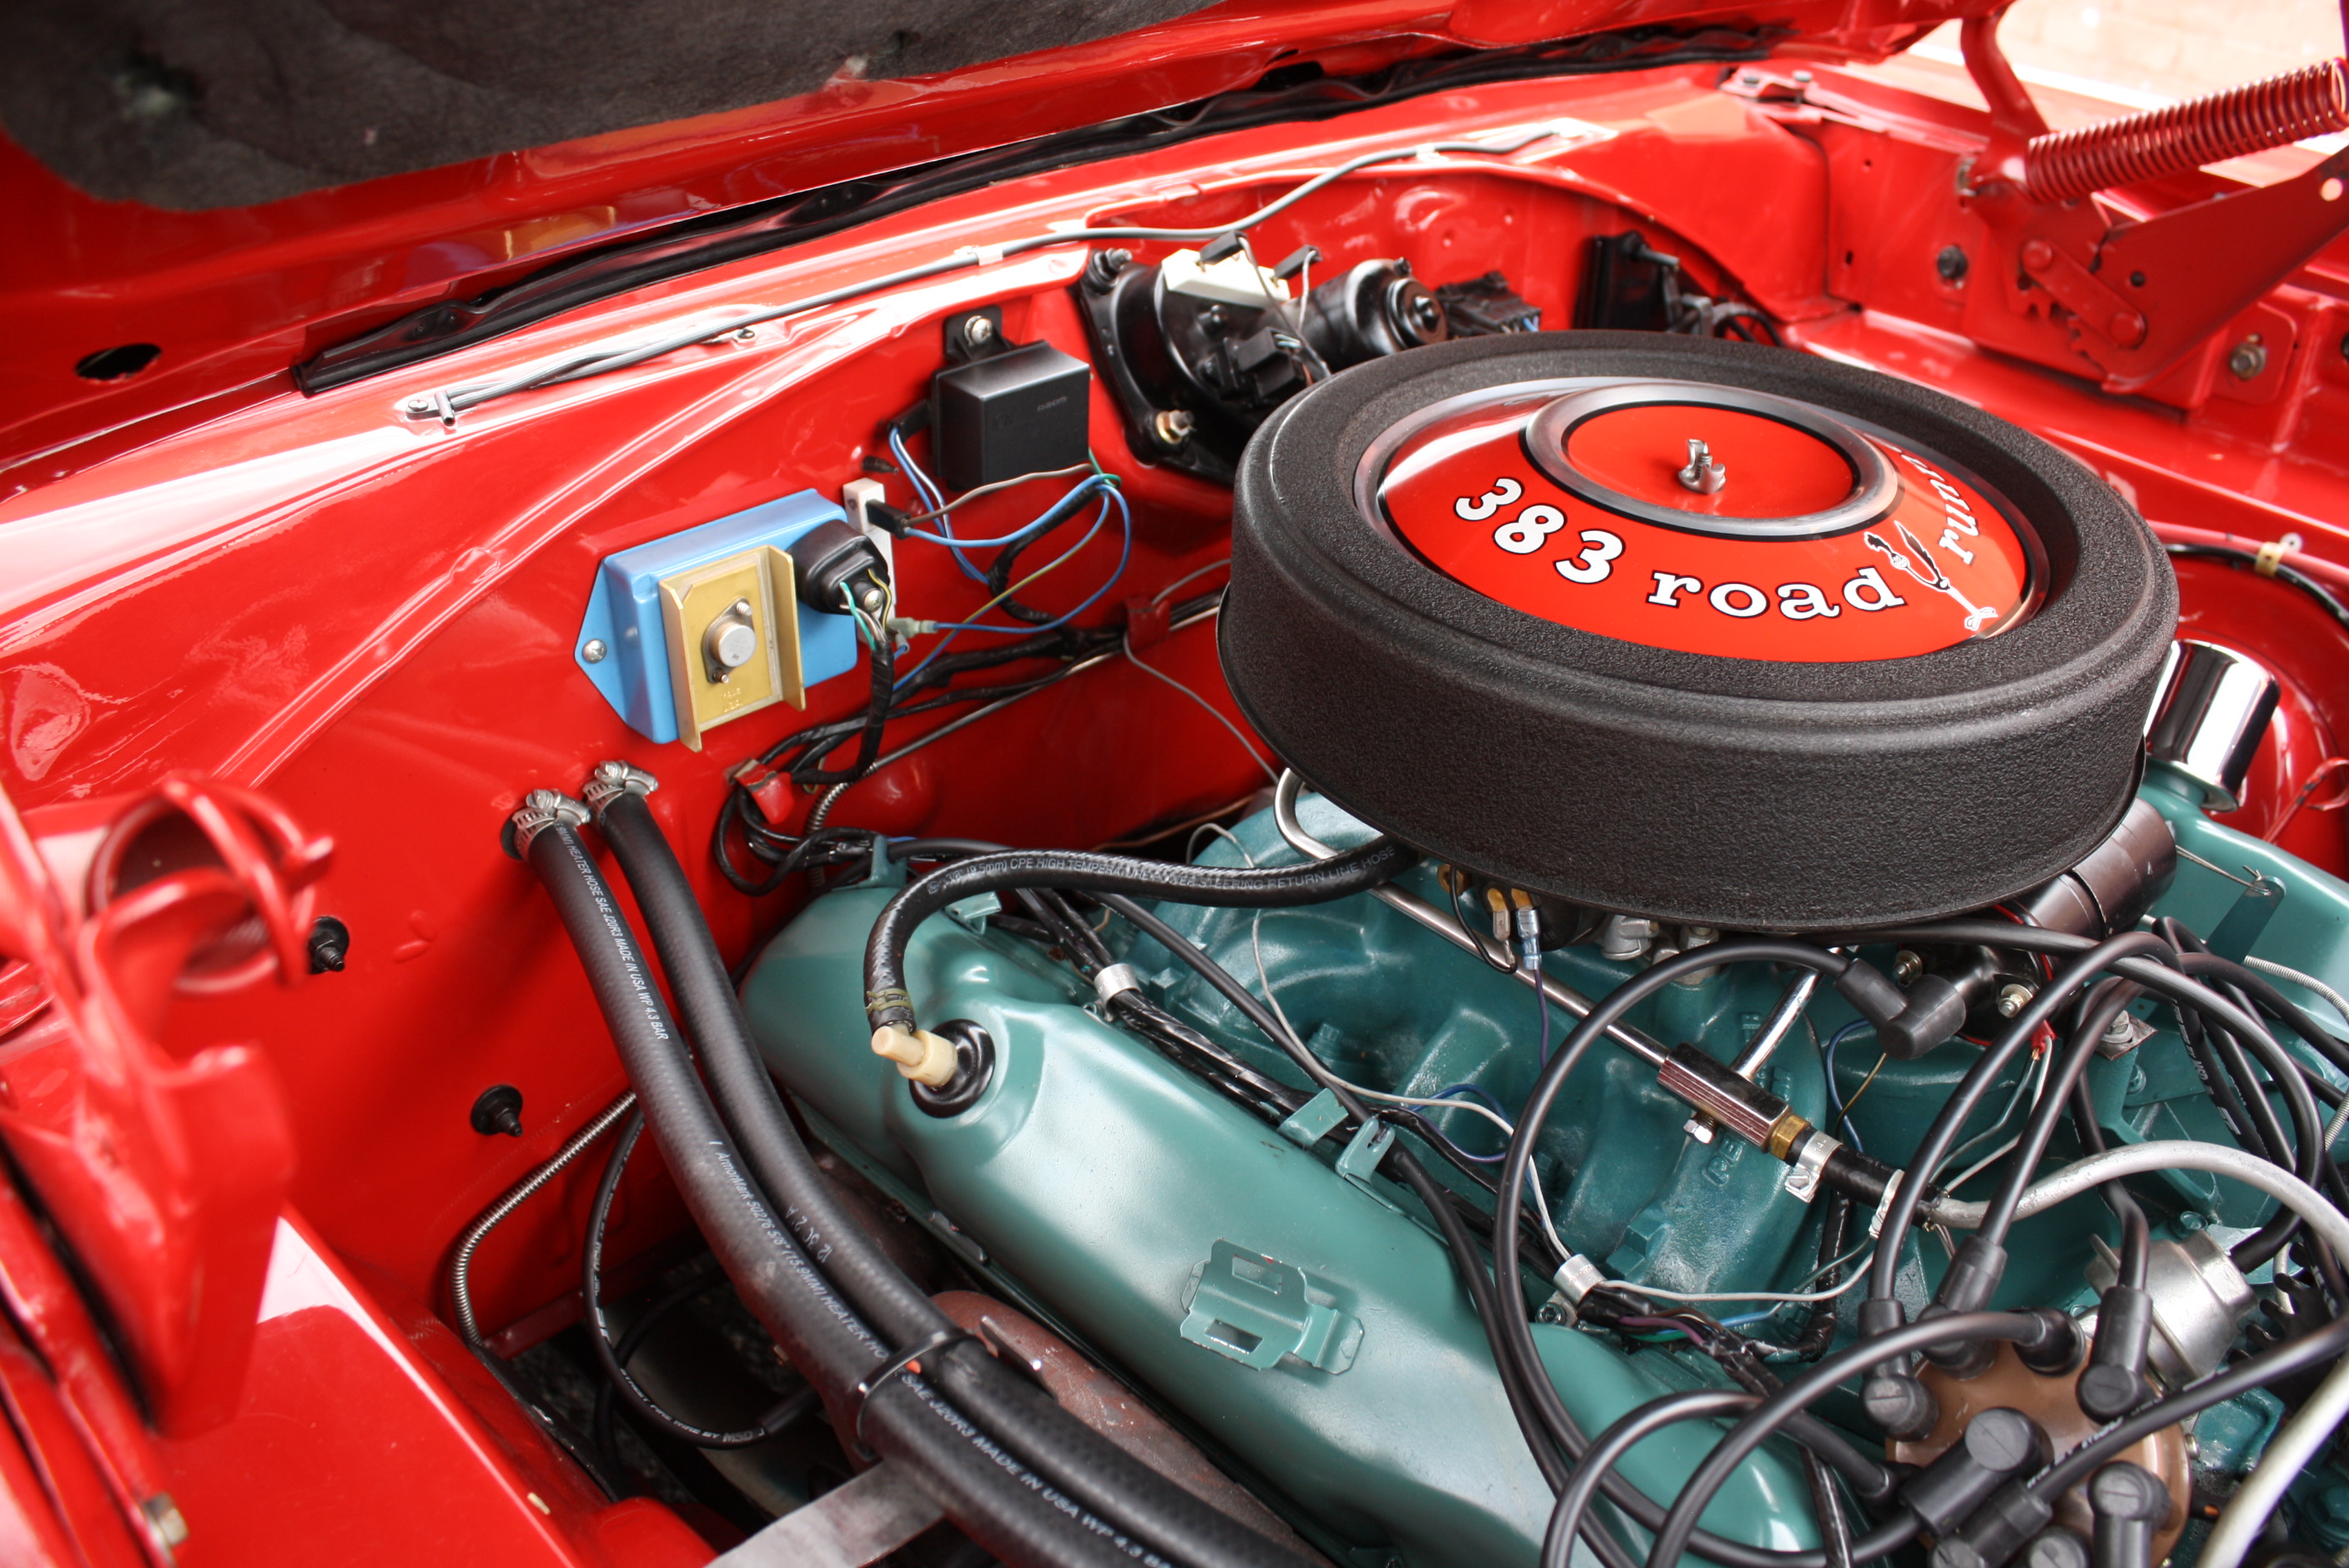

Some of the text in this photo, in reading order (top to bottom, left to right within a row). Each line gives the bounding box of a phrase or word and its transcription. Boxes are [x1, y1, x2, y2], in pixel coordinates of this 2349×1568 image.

[1454, 477, 1627, 585] 383
[1645, 565, 1905, 621] road
[568, 845, 592, 875] HEATER
[1010, 858, 1033, 870] CPE
[1037, 858, 1064, 870] HIGH
[1200, 876, 1264, 891] STEERING
[1268, 872, 1325, 890] RETURN
[1328, 864, 1360, 880] LINE
[1361, 846, 1396, 869] HOSE
[584, 874, 604, 897] HOSE
[596, 897, 612, 913] SAE
[603, 914, 623, 937] J20R3
[614, 937, 635, 962] MADE
[625, 962, 639, 972] IN
[630, 973, 646, 991] USA
[638, 992, 654, 1006] WP
[645, 1007, 661, 1020] 4.3
[651, 1021, 669, 1040] BAR
[715, 1152, 754, 1200] ArmorMark
[781, 1248, 827, 1296] (15.9MM)
[820, 1295, 870, 1341] HEATER
[902, 1375, 933, 1401] SAE
[929, 1400, 977, 1437] J20R3
[973, 1435, 1024, 1476] MADE
[1020, 1473, 1043, 1490] IN
[1043, 1488, 1079, 1519] USA
[1082, 1514, 1114, 1536] WP
